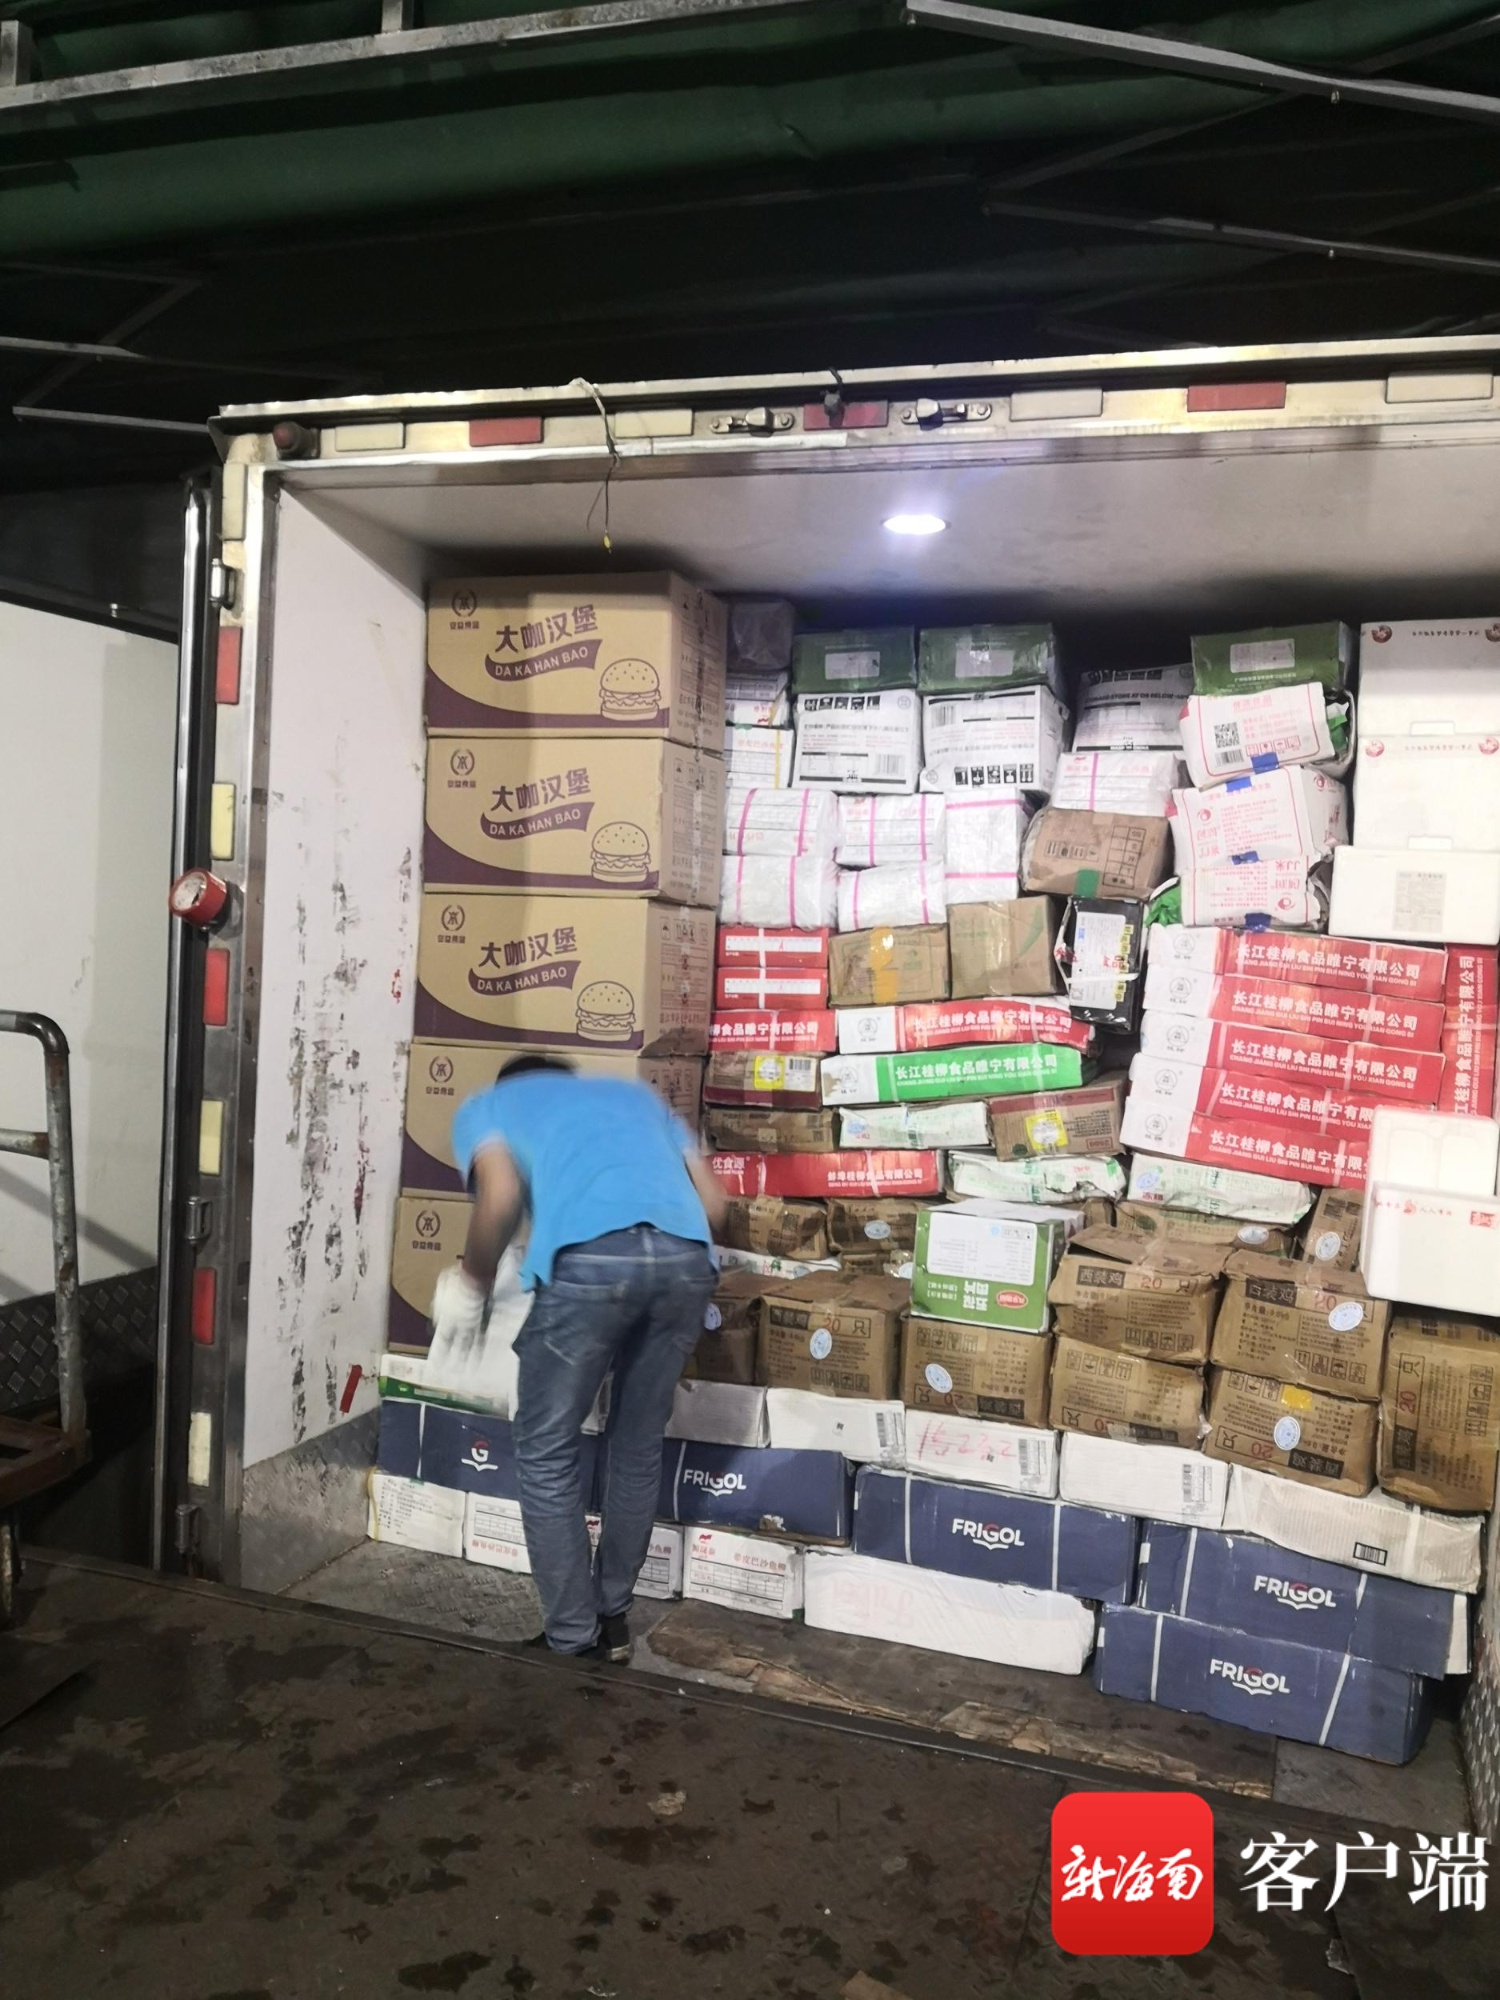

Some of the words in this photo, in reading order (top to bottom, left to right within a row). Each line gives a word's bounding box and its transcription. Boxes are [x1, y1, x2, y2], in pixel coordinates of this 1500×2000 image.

[495, 604, 599, 653] 大咖汉堡
[495, 665, 511, 677] DA
[514, 662, 532, 676] KA
[534, 655, 560, 674] HAN
[562, 646, 588, 664] BAO
[490, 767, 591, 812] 大咖汉堡
[489, 822, 506, 836] DA
[509, 821, 525, 835] KA
[528, 815, 552, 834] HAN
[555, 808, 581, 824] BAO
[478, 926, 577, 969] 大咖汉堡
[1238, 943, 1420, 979] 长江桂柳食品睢宁有限公司
[477, 979, 493, 991] DA
[496, 978, 512, 992] KA
[515, 973, 539, 990] HAN
[542, 966, 567, 982] BAO
[1233, 990, 1418, 1031] 长江桂柳食品睢宁有限公司
[896, 1054, 1057, 1079] 长江桂柳食品睢宁有限公司
[1231, 1039, 1418, 1082] 长江桂柳食品睢宁有限公司
[1221, 1082, 1375, 1122] 长江桂柳食品睢宁有限
[1211, 1129, 1368, 1173] 长江桂柳食品睢宁有限
[1141, 1277, 1162, 1290] 20
[1176, 1279, 1191, 1293] 只
[1314, 1292, 1338, 1310] 20
[824, 1316, 841, 1333] 20
[852, 1319, 866, 1335] 只
[1402, 1361, 1421, 1378] 只
[1399, 1391, 1417, 1415] 20
[1222, 1430, 1239, 1450] 只
[1251, 1441, 1274, 1460] 20
[683, 1467, 747, 1491] FRIGOL
[952, 1518, 1025, 1547] FRIGOL
[1253, 1574, 1337, 1608] FRIGOL
[1209, 1658, 1290, 1694] FRIGOL
